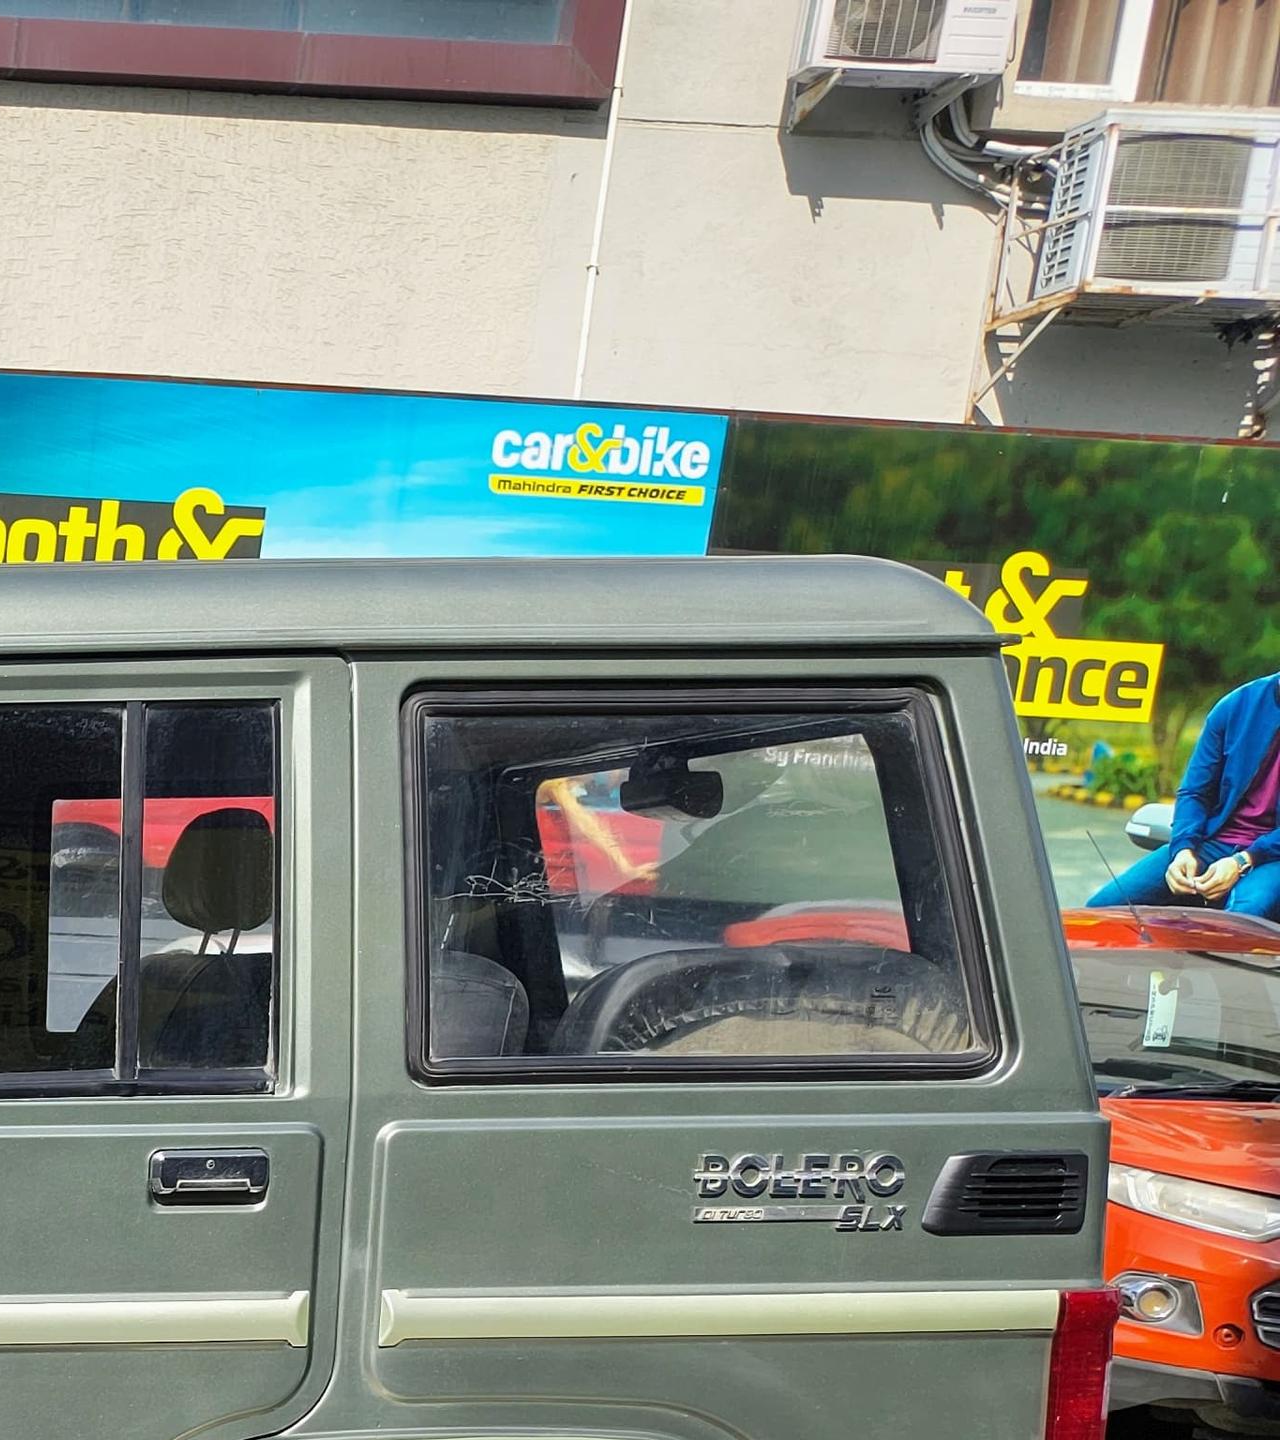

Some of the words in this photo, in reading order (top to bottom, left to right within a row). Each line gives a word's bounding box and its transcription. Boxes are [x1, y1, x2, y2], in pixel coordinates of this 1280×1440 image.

[491, 422, 711, 479] car&bike
[496, 479, 572, 494] Mahindra
[577, 484, 626, 498] FIRST
[627, 487, 687, 501] CHOICE
[1023, 737, 1068, 756] India
[694, 1153, 906, 1204] BOLERO
[836, 1204, 908, 1232] SLX
